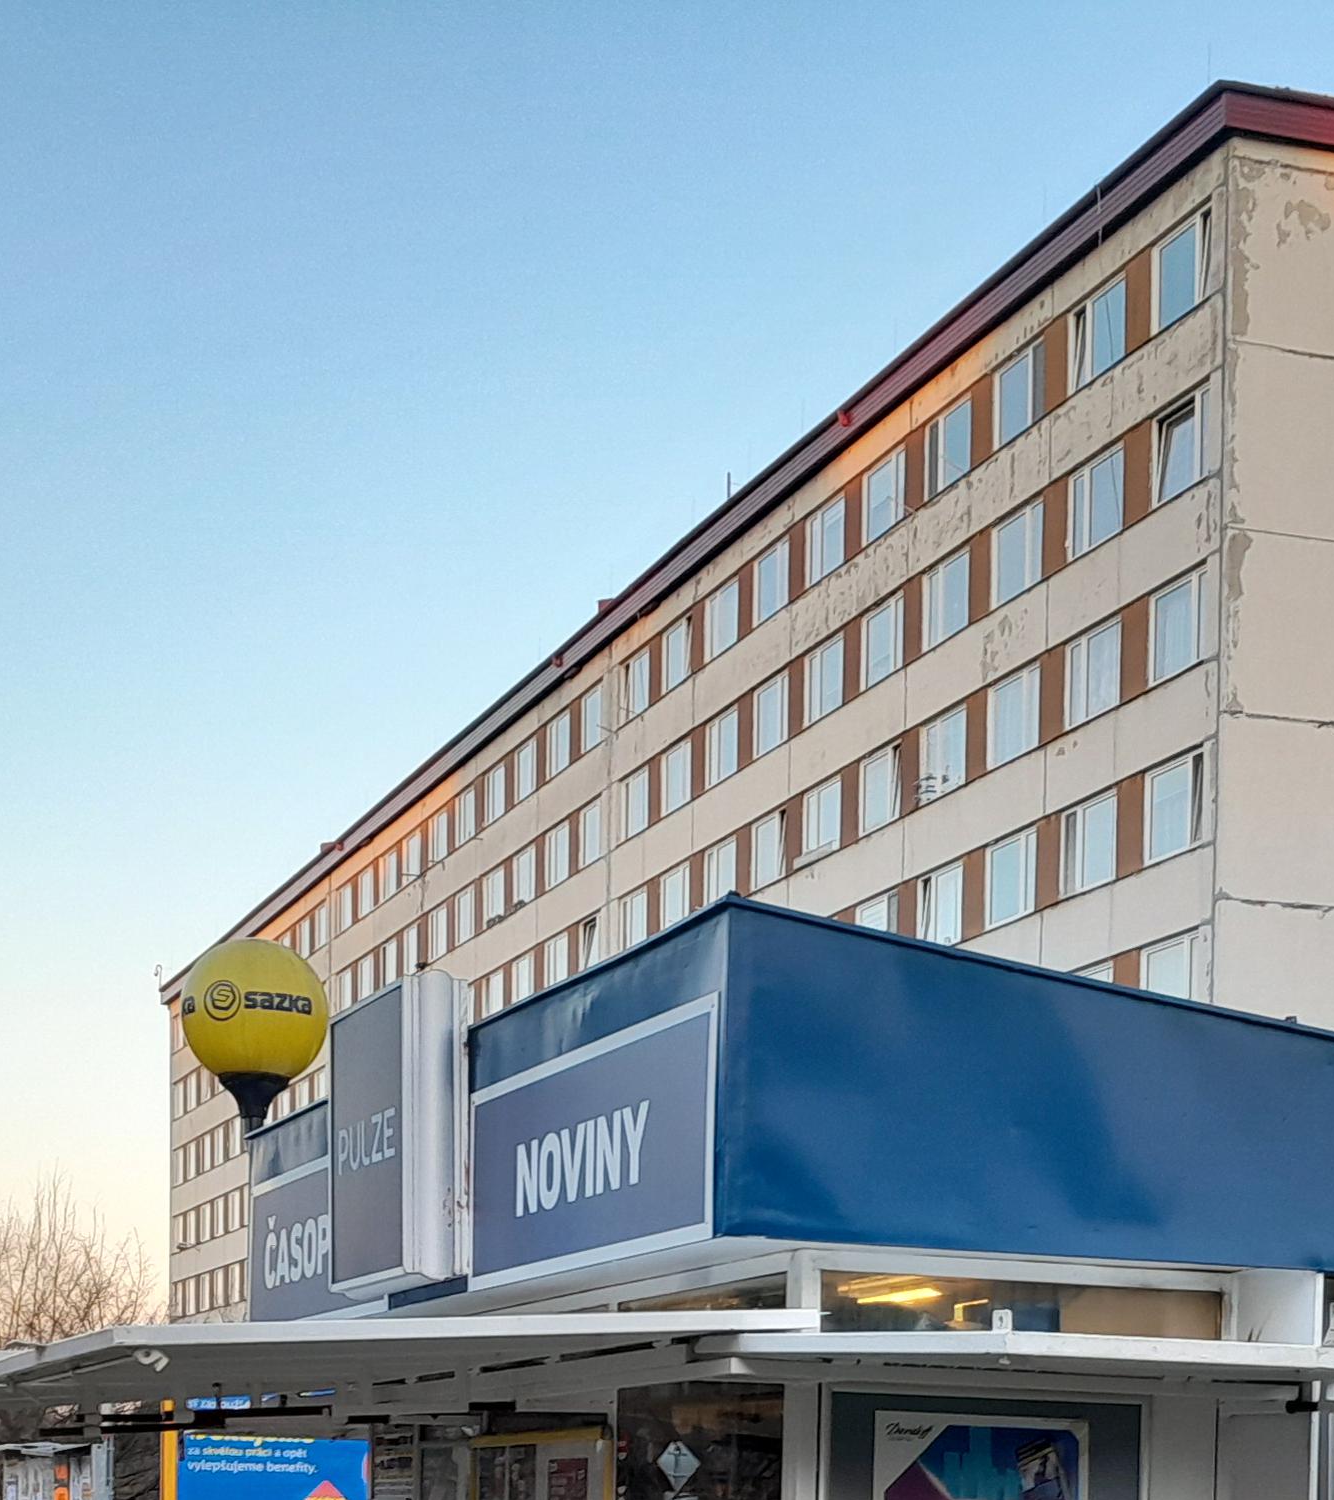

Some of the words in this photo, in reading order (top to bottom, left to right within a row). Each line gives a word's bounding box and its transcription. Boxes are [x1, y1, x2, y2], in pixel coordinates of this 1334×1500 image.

[338, 1107, 397, 1176] PULZE
[515, 1099, 650, 1218] NOVINY
[187, 1459, 265, 1474] vylepšujeme
[266, 1461, 318, 1476] benefity.
